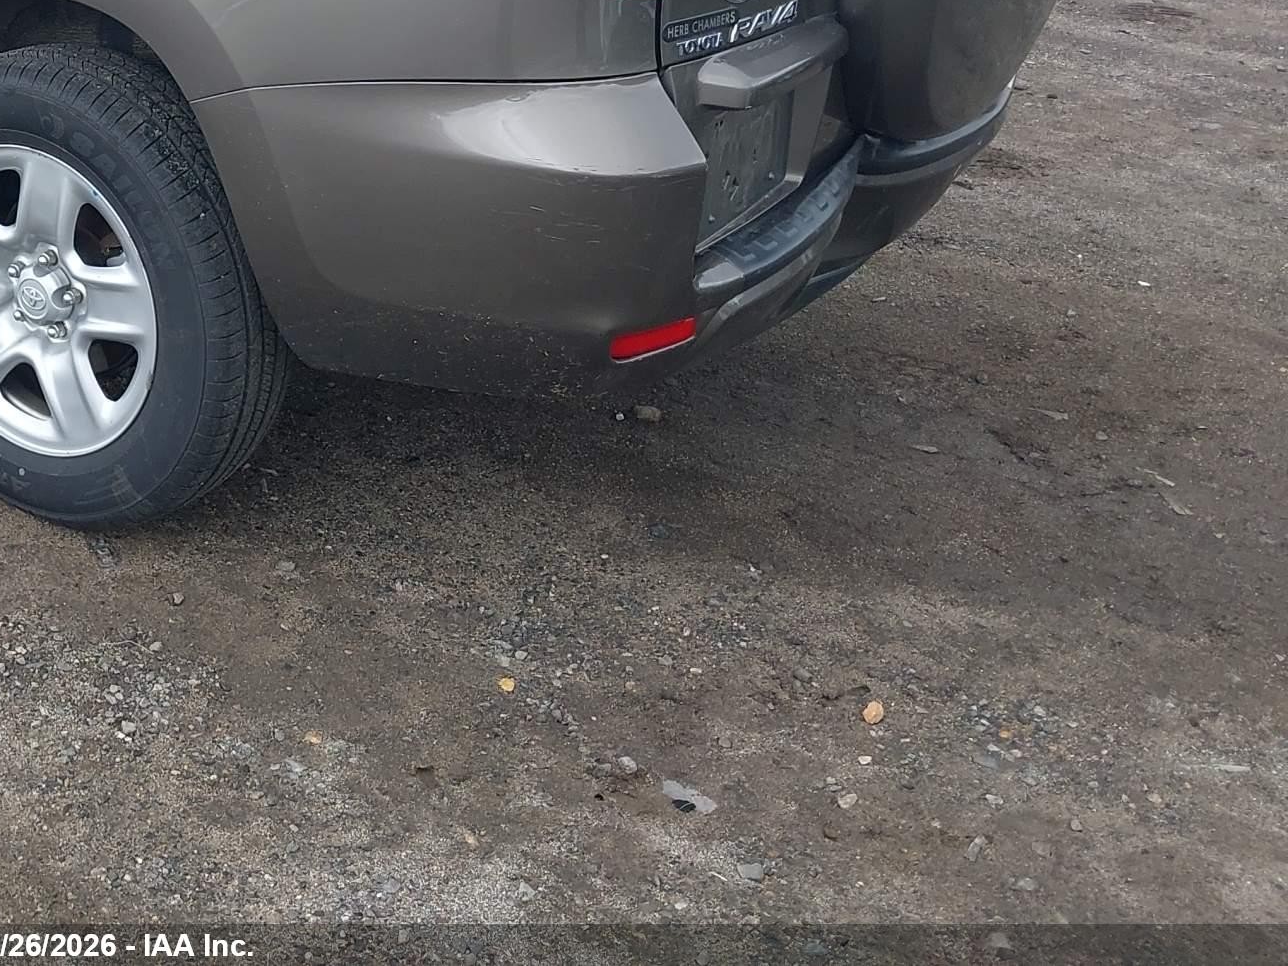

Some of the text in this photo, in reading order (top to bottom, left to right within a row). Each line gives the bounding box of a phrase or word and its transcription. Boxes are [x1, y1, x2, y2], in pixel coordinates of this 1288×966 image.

[667, 11, 736, 39] HERB CHAMBERS
[676, 31, 723, 57] TOYOTA
